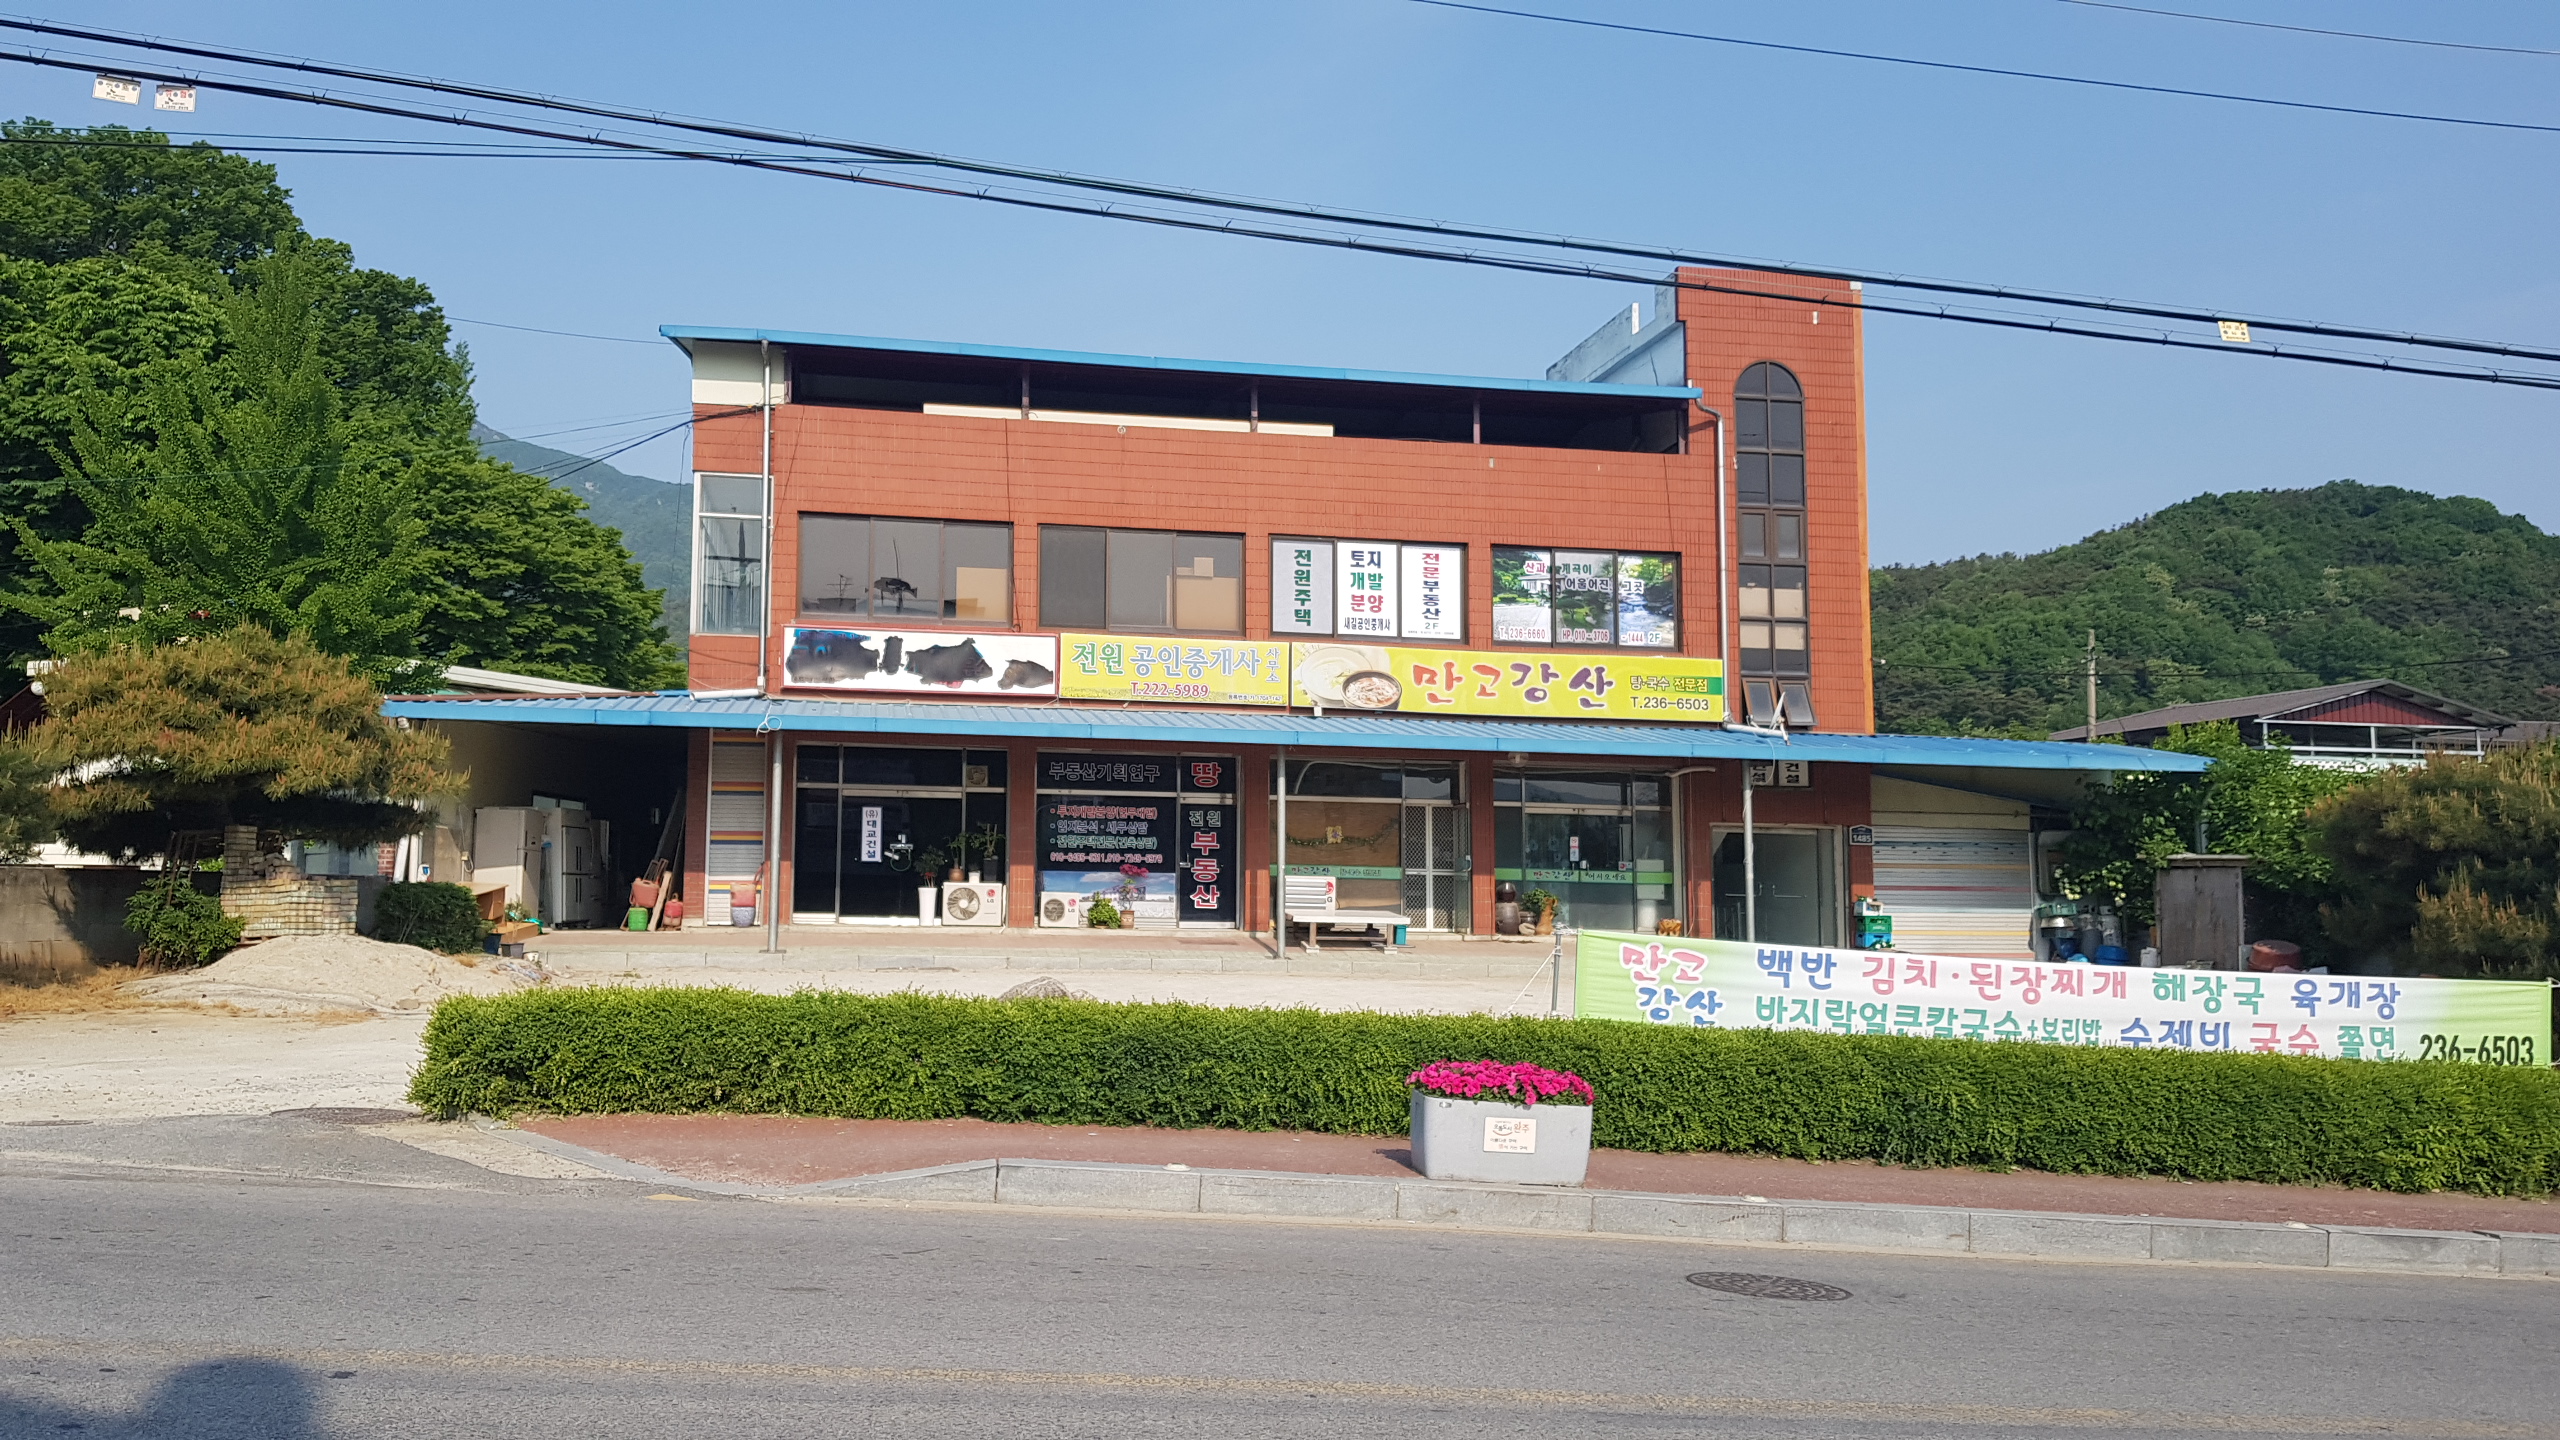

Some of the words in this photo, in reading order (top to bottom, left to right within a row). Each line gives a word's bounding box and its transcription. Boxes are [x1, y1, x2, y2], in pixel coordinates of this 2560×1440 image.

[1350, 550, 1382, 569] 토지
[1524, 562, 1547, 574] 산과
[1293, 549, 1312, 626] 전원주택
[1350, 572, 1384, 591] 개발
[1623, 580, 1645, 593] 그곳
[1350, 594, 1384, 614] 분양
[1344, 617, 1391, 631] 새길공인중개사
[1424, 622, 1439, 630] 2F
[1649, 633, 1661, 643] 2F
[1072, 642, 1125, 676] 전원
[1129, 645, 1262, 679] 공인중개사
[1265, 647, 1281, 683] 사무소
[1130, 681, 1210, 698] T.222-5989
[1412, 661, 1616, 709] 만고강산
[1673, 677, 1709, 693] 전문점
[1630, 696, 1709, 711] T.236-6503
[1049, 762, 1160, 783] 부동산기획연구
[1191, 762, 1221, 787] 땅
[1189, 810, 1221, 827] 전원
[1190, 831, 1220, 909] 부동산
[1622, 944, 1706, 982] 만고
[1757, 949, 1838, 991] 백반
[2152, 971, 2265, 1015] 해장국
[2291, 979, 2401, 1021] 육개장
[1638, 987, 1724, 1026] 강산
[2120, 1017, 2231, 1048] 수제비
[2337, 1025, 2395, 1061] 쫄면
[2419, 1034, 2534, 1067] 236-6503
